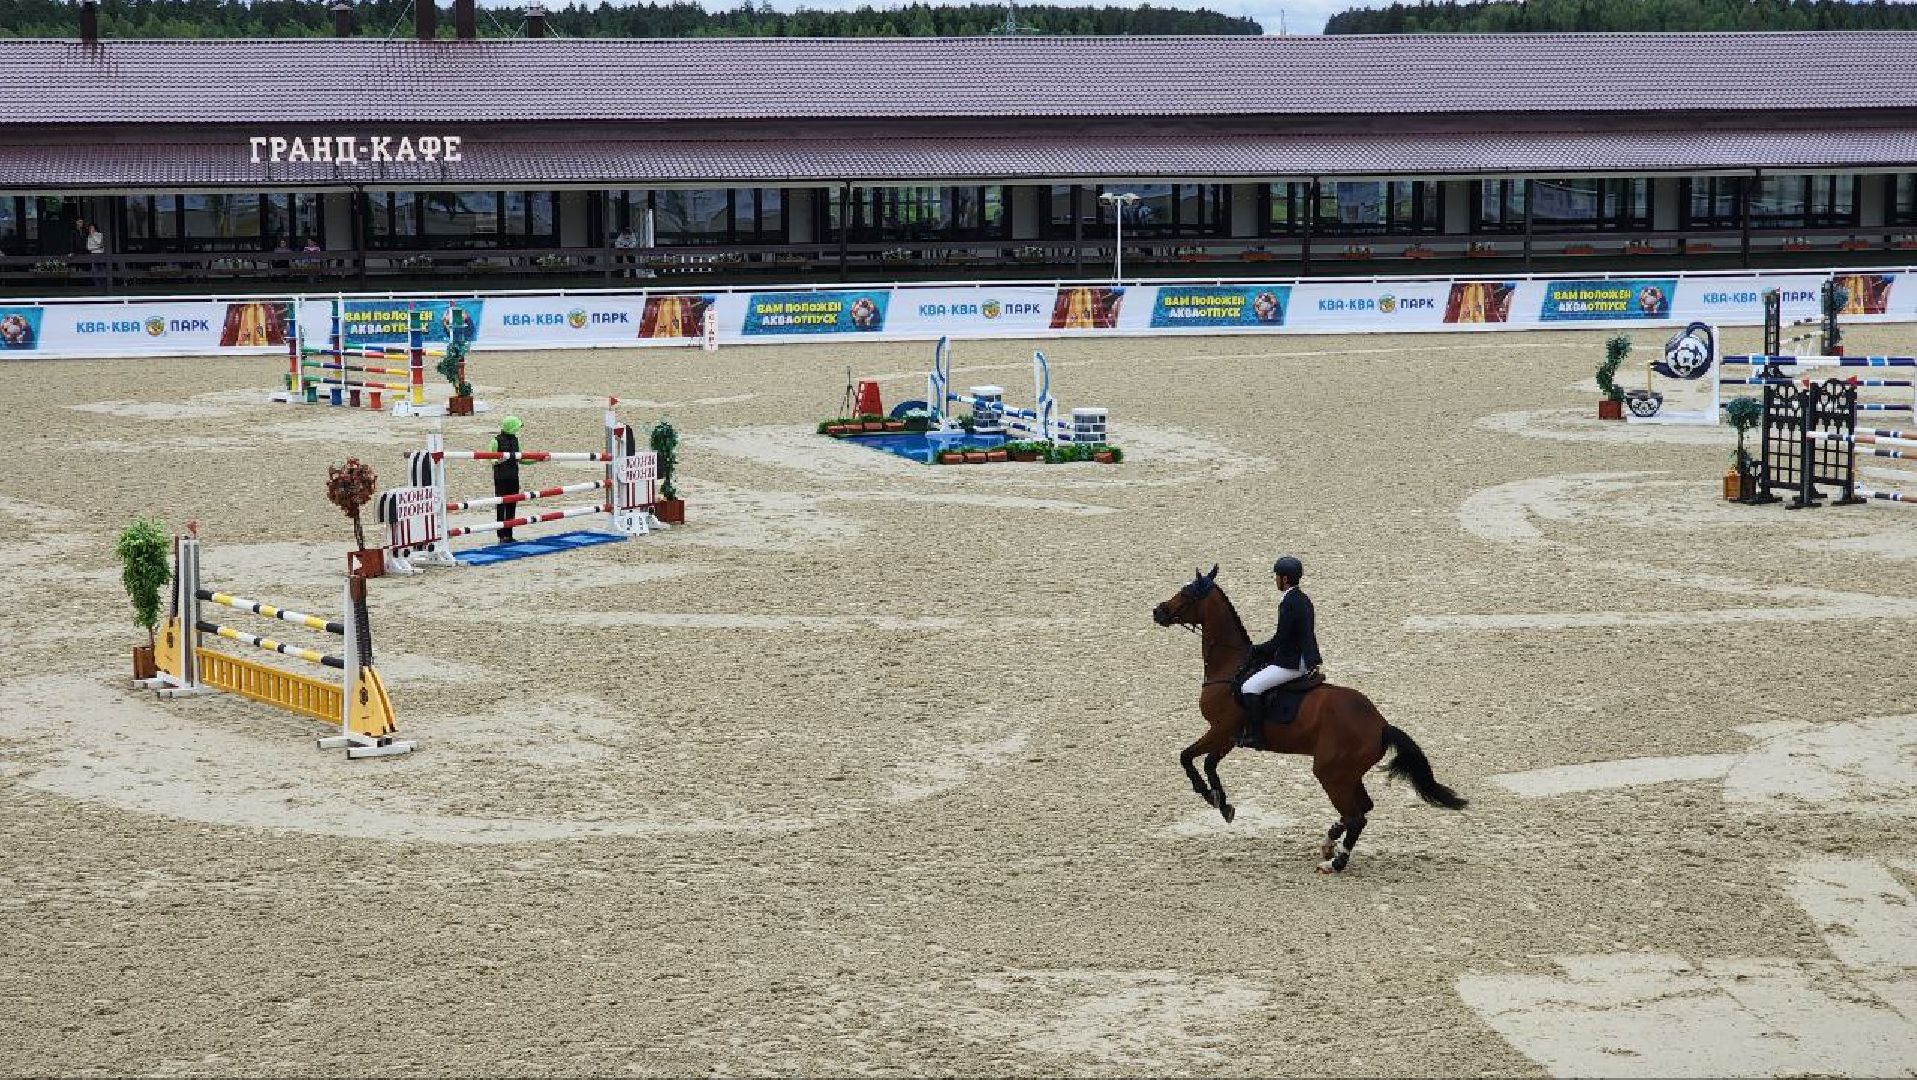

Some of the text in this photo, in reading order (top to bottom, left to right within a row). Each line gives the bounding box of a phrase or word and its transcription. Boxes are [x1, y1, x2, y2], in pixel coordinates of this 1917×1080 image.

[250, 136, 462, 166] ГРАНД-КАФЕ
[1165, 295, 1245, 306] ВАМ ПОЛОЖЕН
[1554, 289, 1632, 300] ВАМ ПОЛОЖЕН
[1782, 291, 1815, 302] ПАРК
[756, 301, 842, 314] ВАМ ПОЛОЖЕН
[1006, 303, 1040, 315] ПАРК
[1400, 298, 1434, 309] ПАРК
[1559, 300, 1627, 312] АКВАОТПУСК
[344, 310, 432, 321] ВАМ ПОЛОЕН
[592, 312, 629, 324] ПАРК
[1169, 307, 1241, 318] АКВАОТПУСК
[170, 320, 209, 332] ПАРК
[762, 314, 838, 326] АКВАОТПУСК
